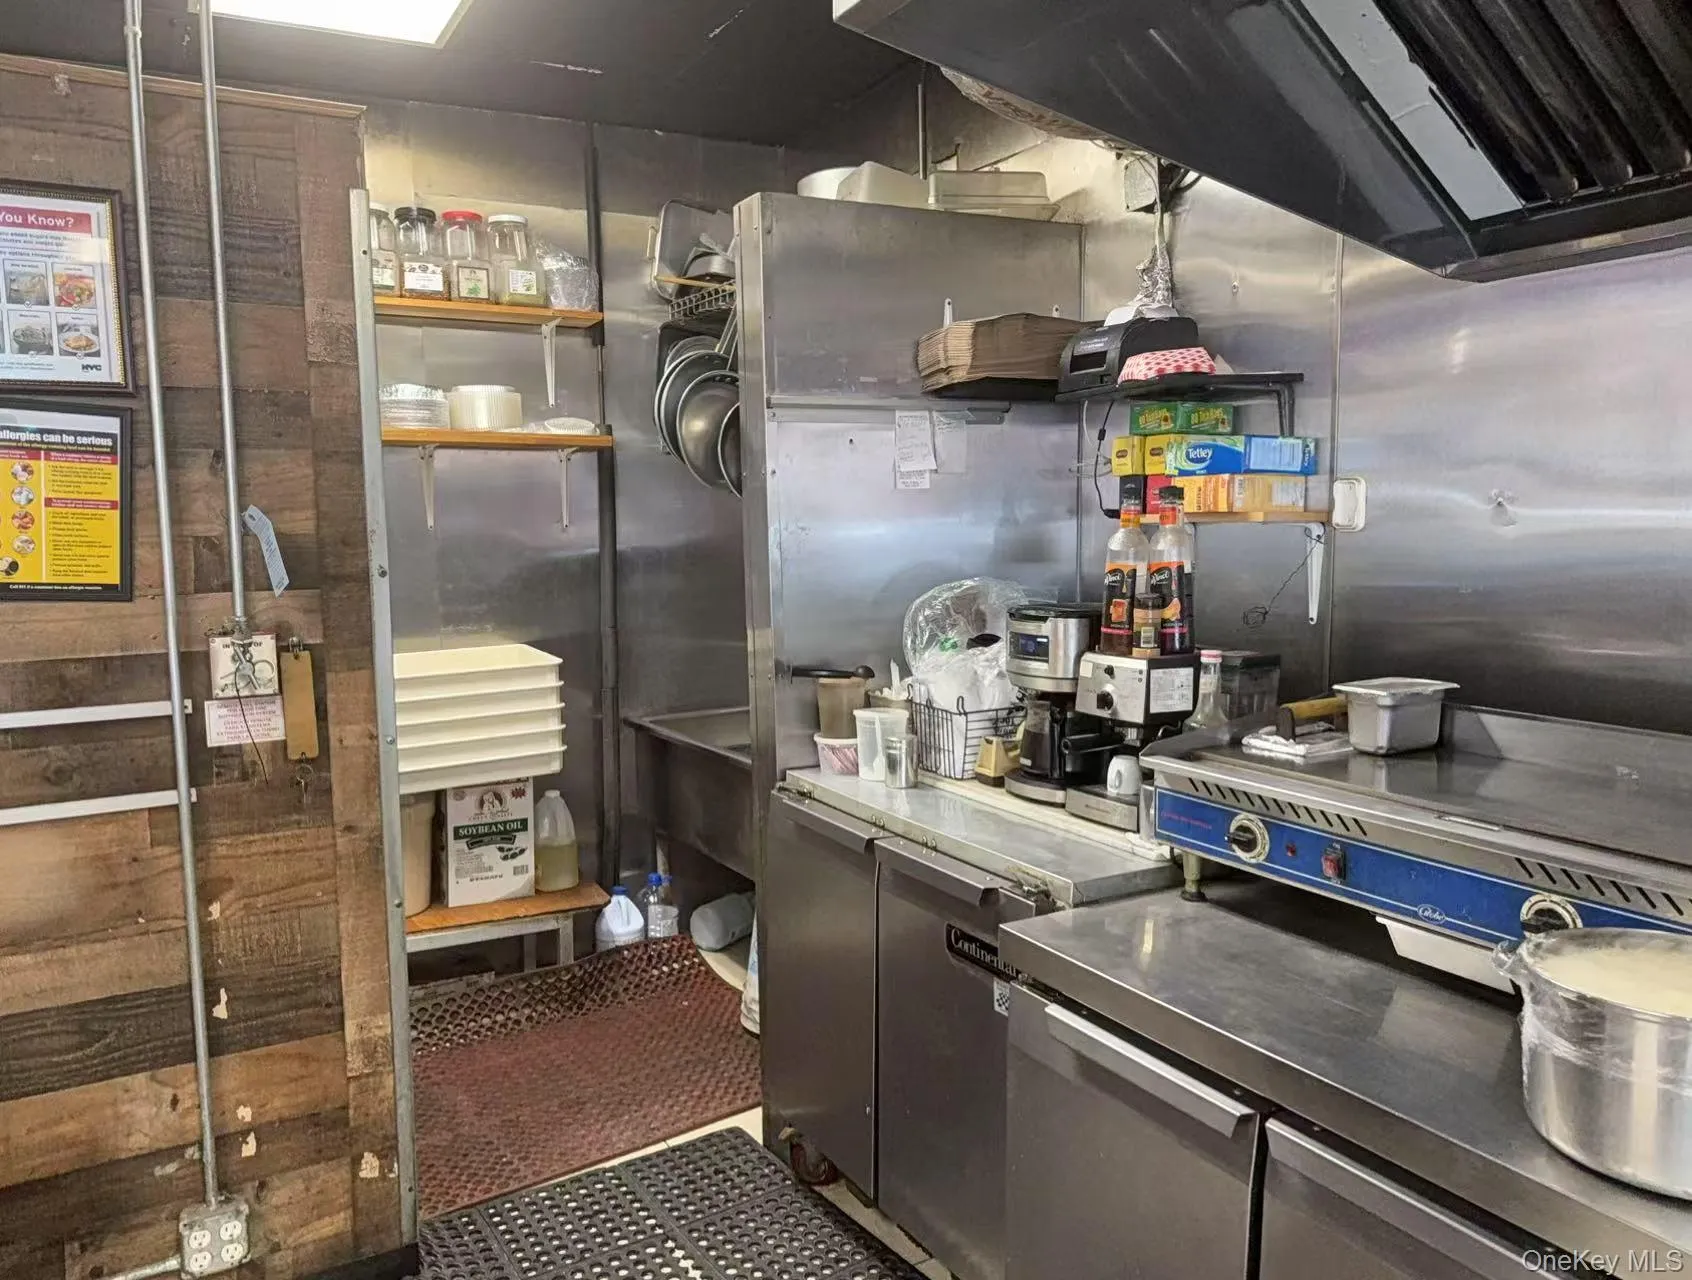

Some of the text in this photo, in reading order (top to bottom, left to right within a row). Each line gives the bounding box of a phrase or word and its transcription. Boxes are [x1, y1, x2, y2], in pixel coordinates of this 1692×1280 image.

[27, 213, 75, 228] Know?
[81, 363, 102, 371] NYC
[42, 433, 61, 443] can
[62, 434, 76, 444] be
[76, 437, 113, 446] serious
[1187, 446, 1213, 460] Tetley
[458, 821, 524, 837] SOYBEAN OIL
